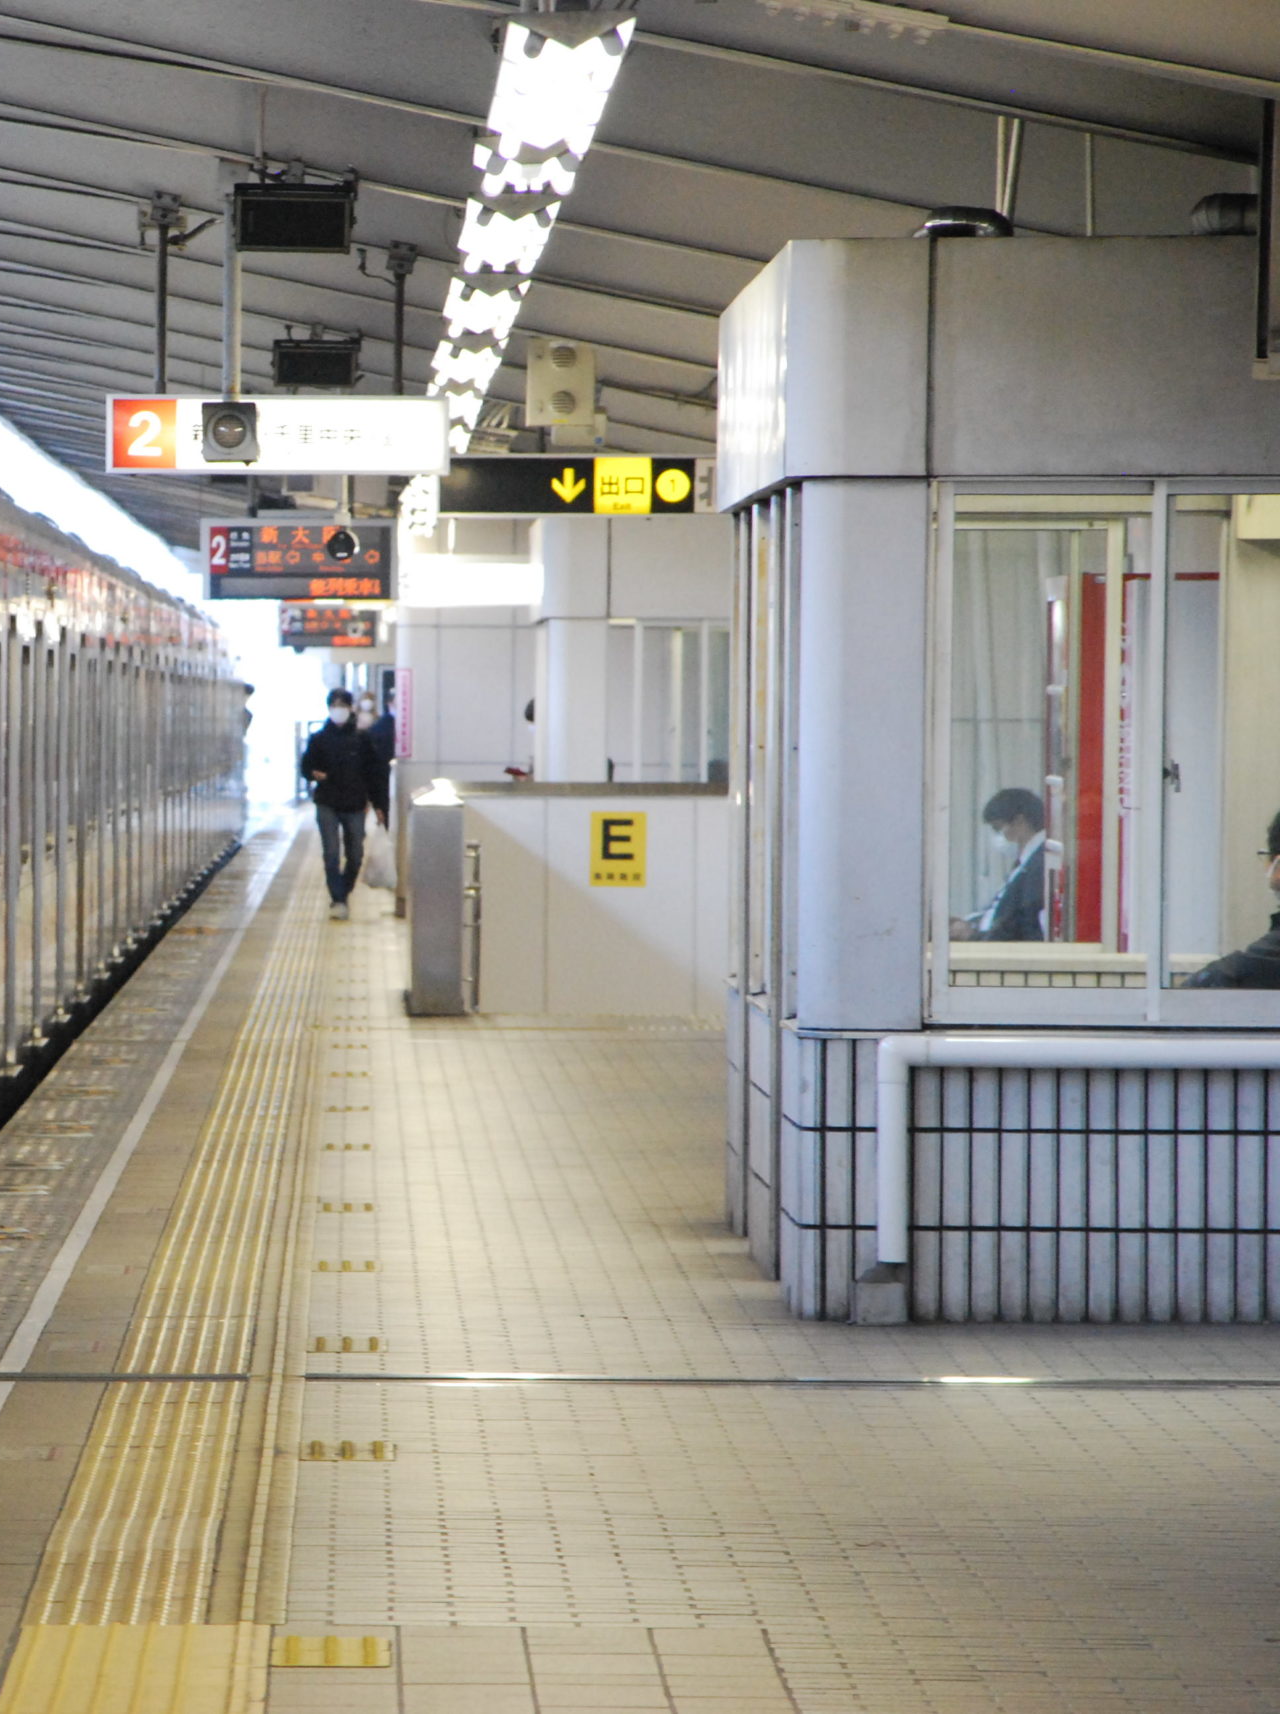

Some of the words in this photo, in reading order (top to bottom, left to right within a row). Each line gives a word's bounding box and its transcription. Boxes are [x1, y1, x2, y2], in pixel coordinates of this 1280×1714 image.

[127, 410, 162, 457] 2
[600, 475, 645, 496] 出口
[211, 535, 226, 565] 2
[602, 819, 634, 860] E
